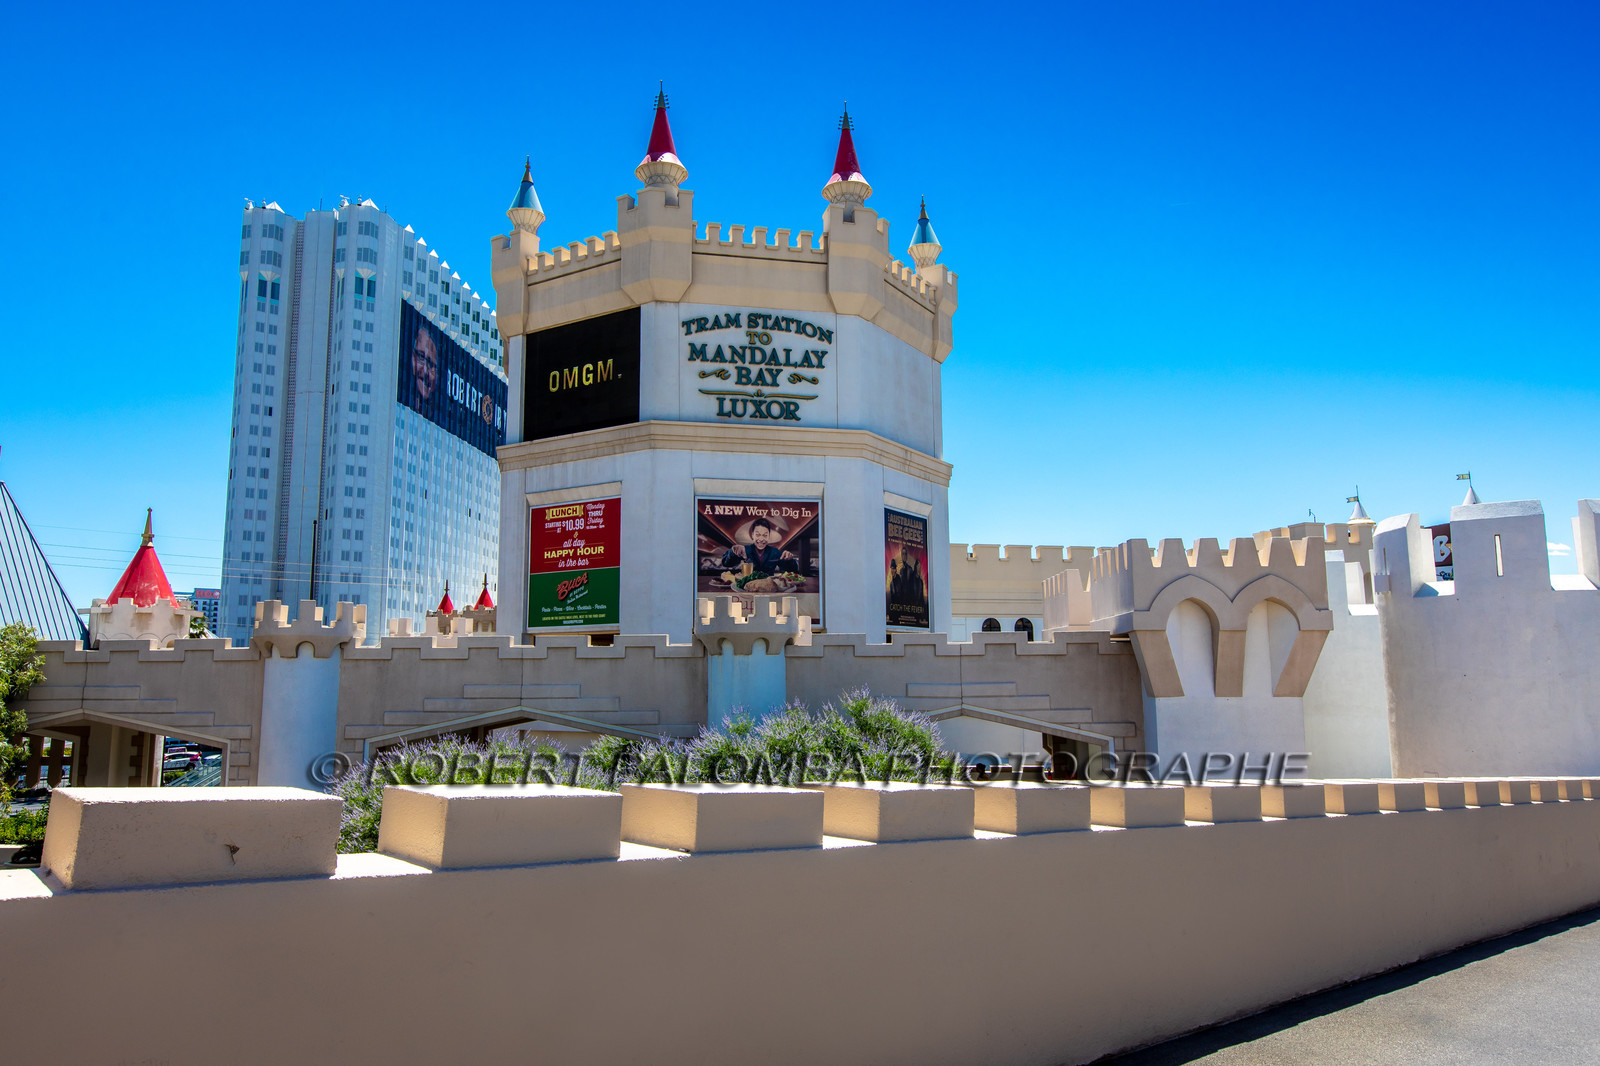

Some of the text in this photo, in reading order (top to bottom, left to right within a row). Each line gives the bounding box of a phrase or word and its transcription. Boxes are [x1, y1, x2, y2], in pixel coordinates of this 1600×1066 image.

[682, 313, 834, 344] TRAM STATION
[746, 331, 772, 345] TO
[688, 343, 828, 368] MANDALAY
[550, 359, 622, 392] OMGM.
[735, 366, 783, 387] BAY
[446, 368, 482, 416] ROBERT
[716, 397, 801, 421] LUXOR
[552, 507, 577, 517] LUNCH
[704, 505, 812, 519] A NEW Way to Dig In
[562, 518, 584, 531] $10.99
[890, 513, 923, 530] AUSTRALIAN
[888, 523, 902, 537] BEE
[902, 527, 921, 542] GEES
[563, 538, 585, 549] all day
[544, 546, 604, 559] HAPPY HOUR
[566, 559, 577, 567] the
